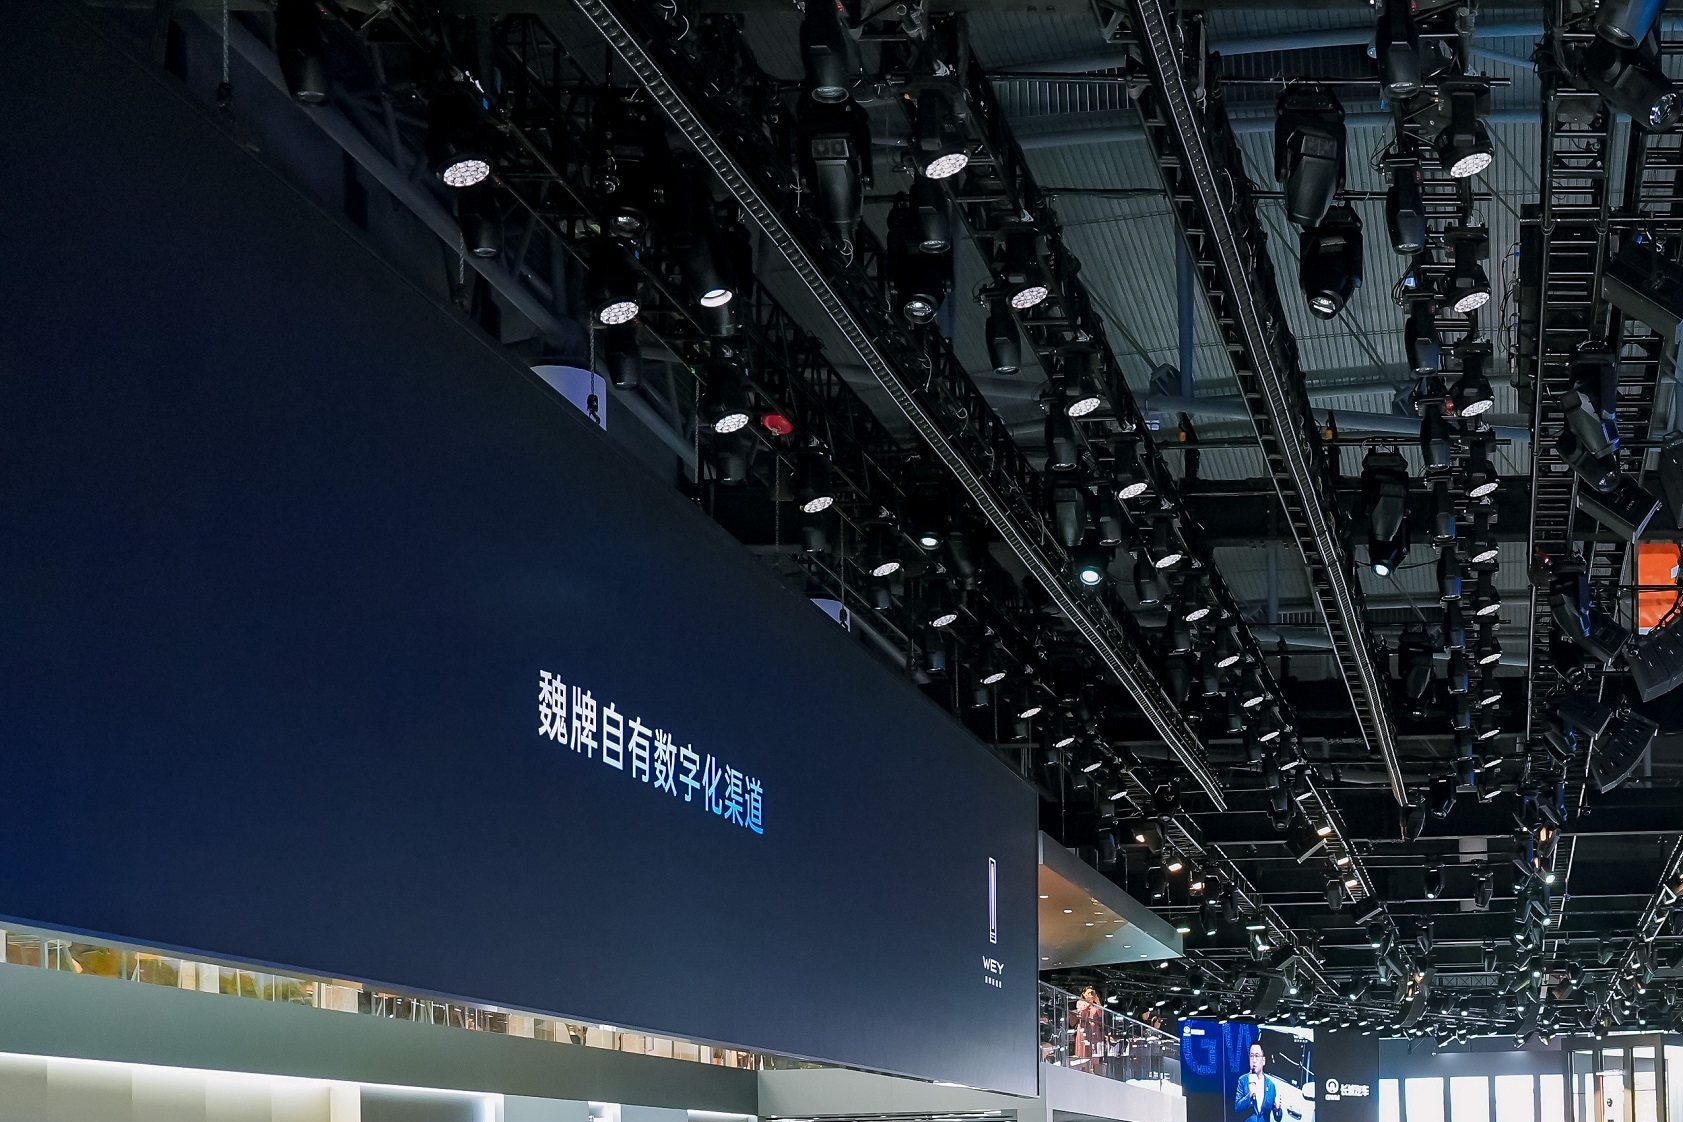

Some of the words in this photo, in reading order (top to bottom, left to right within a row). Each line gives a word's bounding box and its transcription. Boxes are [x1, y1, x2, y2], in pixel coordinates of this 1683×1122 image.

[538, 669, 763, 835] 魏牌自有数字化渠道
[982, 955, 1004, 975] WEY
